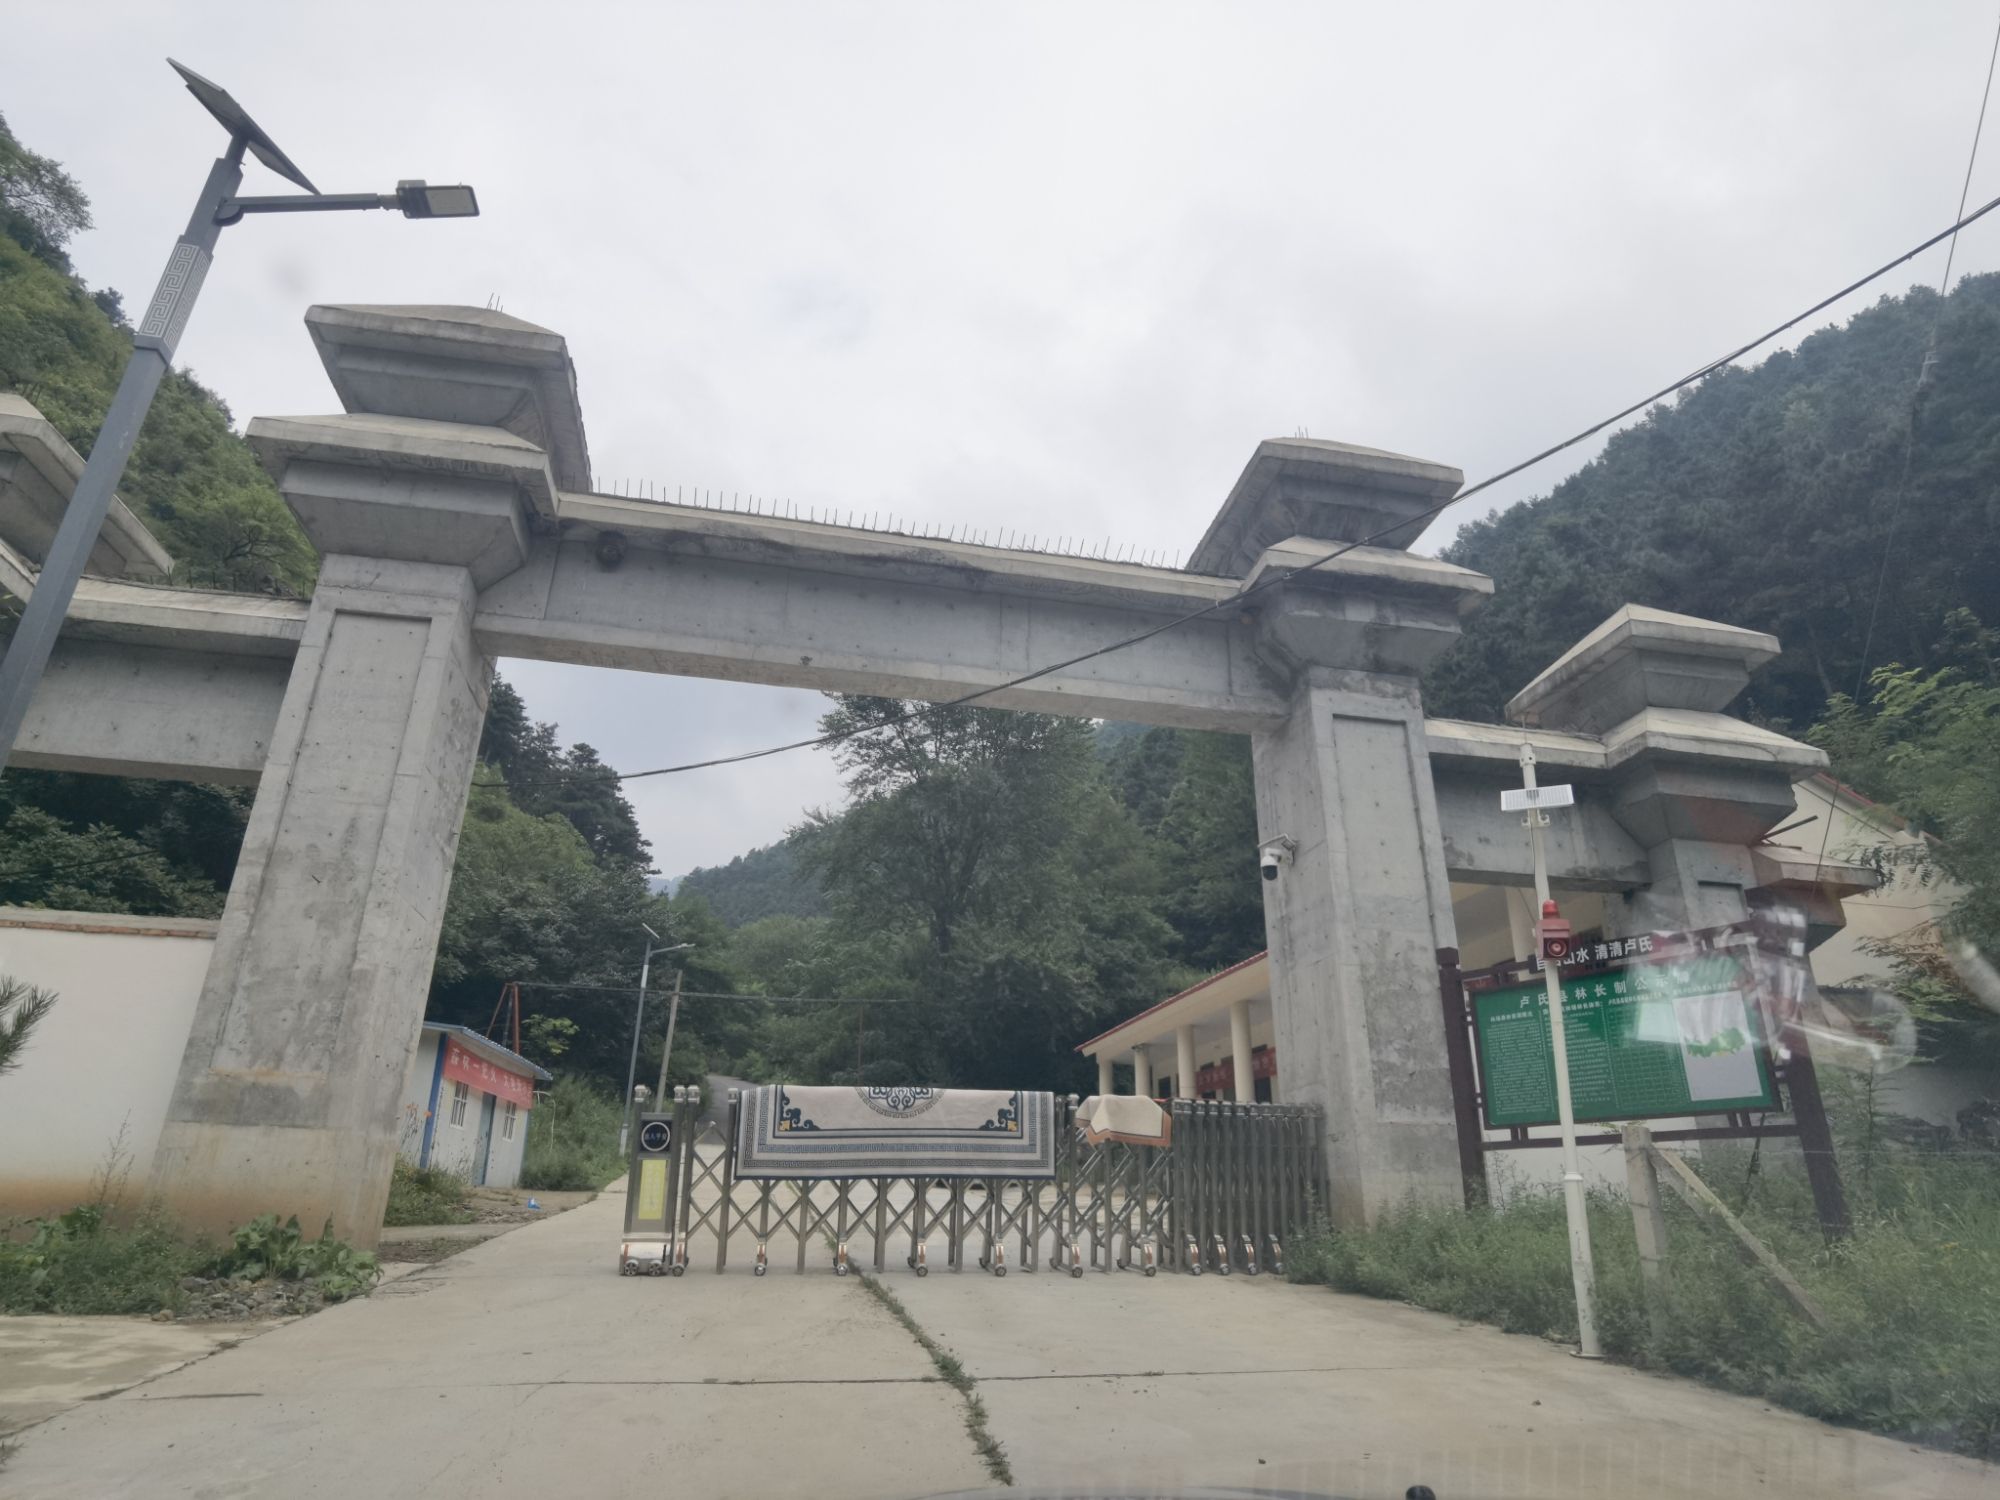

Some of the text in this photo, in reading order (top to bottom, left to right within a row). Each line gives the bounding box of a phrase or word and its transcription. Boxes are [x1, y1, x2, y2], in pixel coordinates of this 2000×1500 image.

[1537, 935, 1653, 971] 山水 清清卢氏
